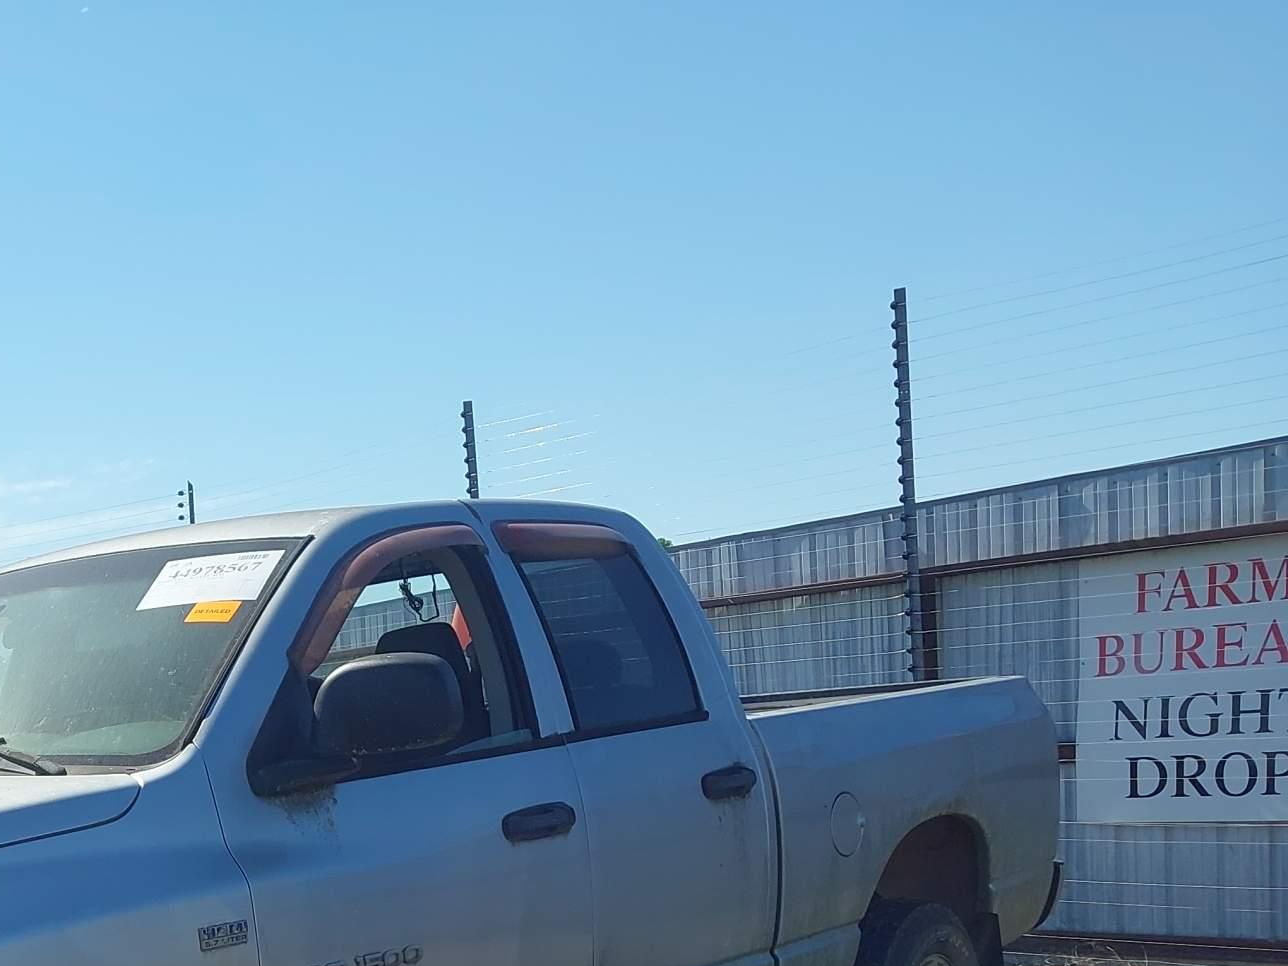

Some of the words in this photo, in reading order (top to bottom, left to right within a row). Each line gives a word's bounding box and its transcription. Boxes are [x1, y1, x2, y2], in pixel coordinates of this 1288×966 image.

[169, 561, 264, 579] 44978567
[1134, 556, 1288, 614] FARM
[1109, 688, 1288, 741] NIGH
[1124, 751, 1288, 799] DROP
